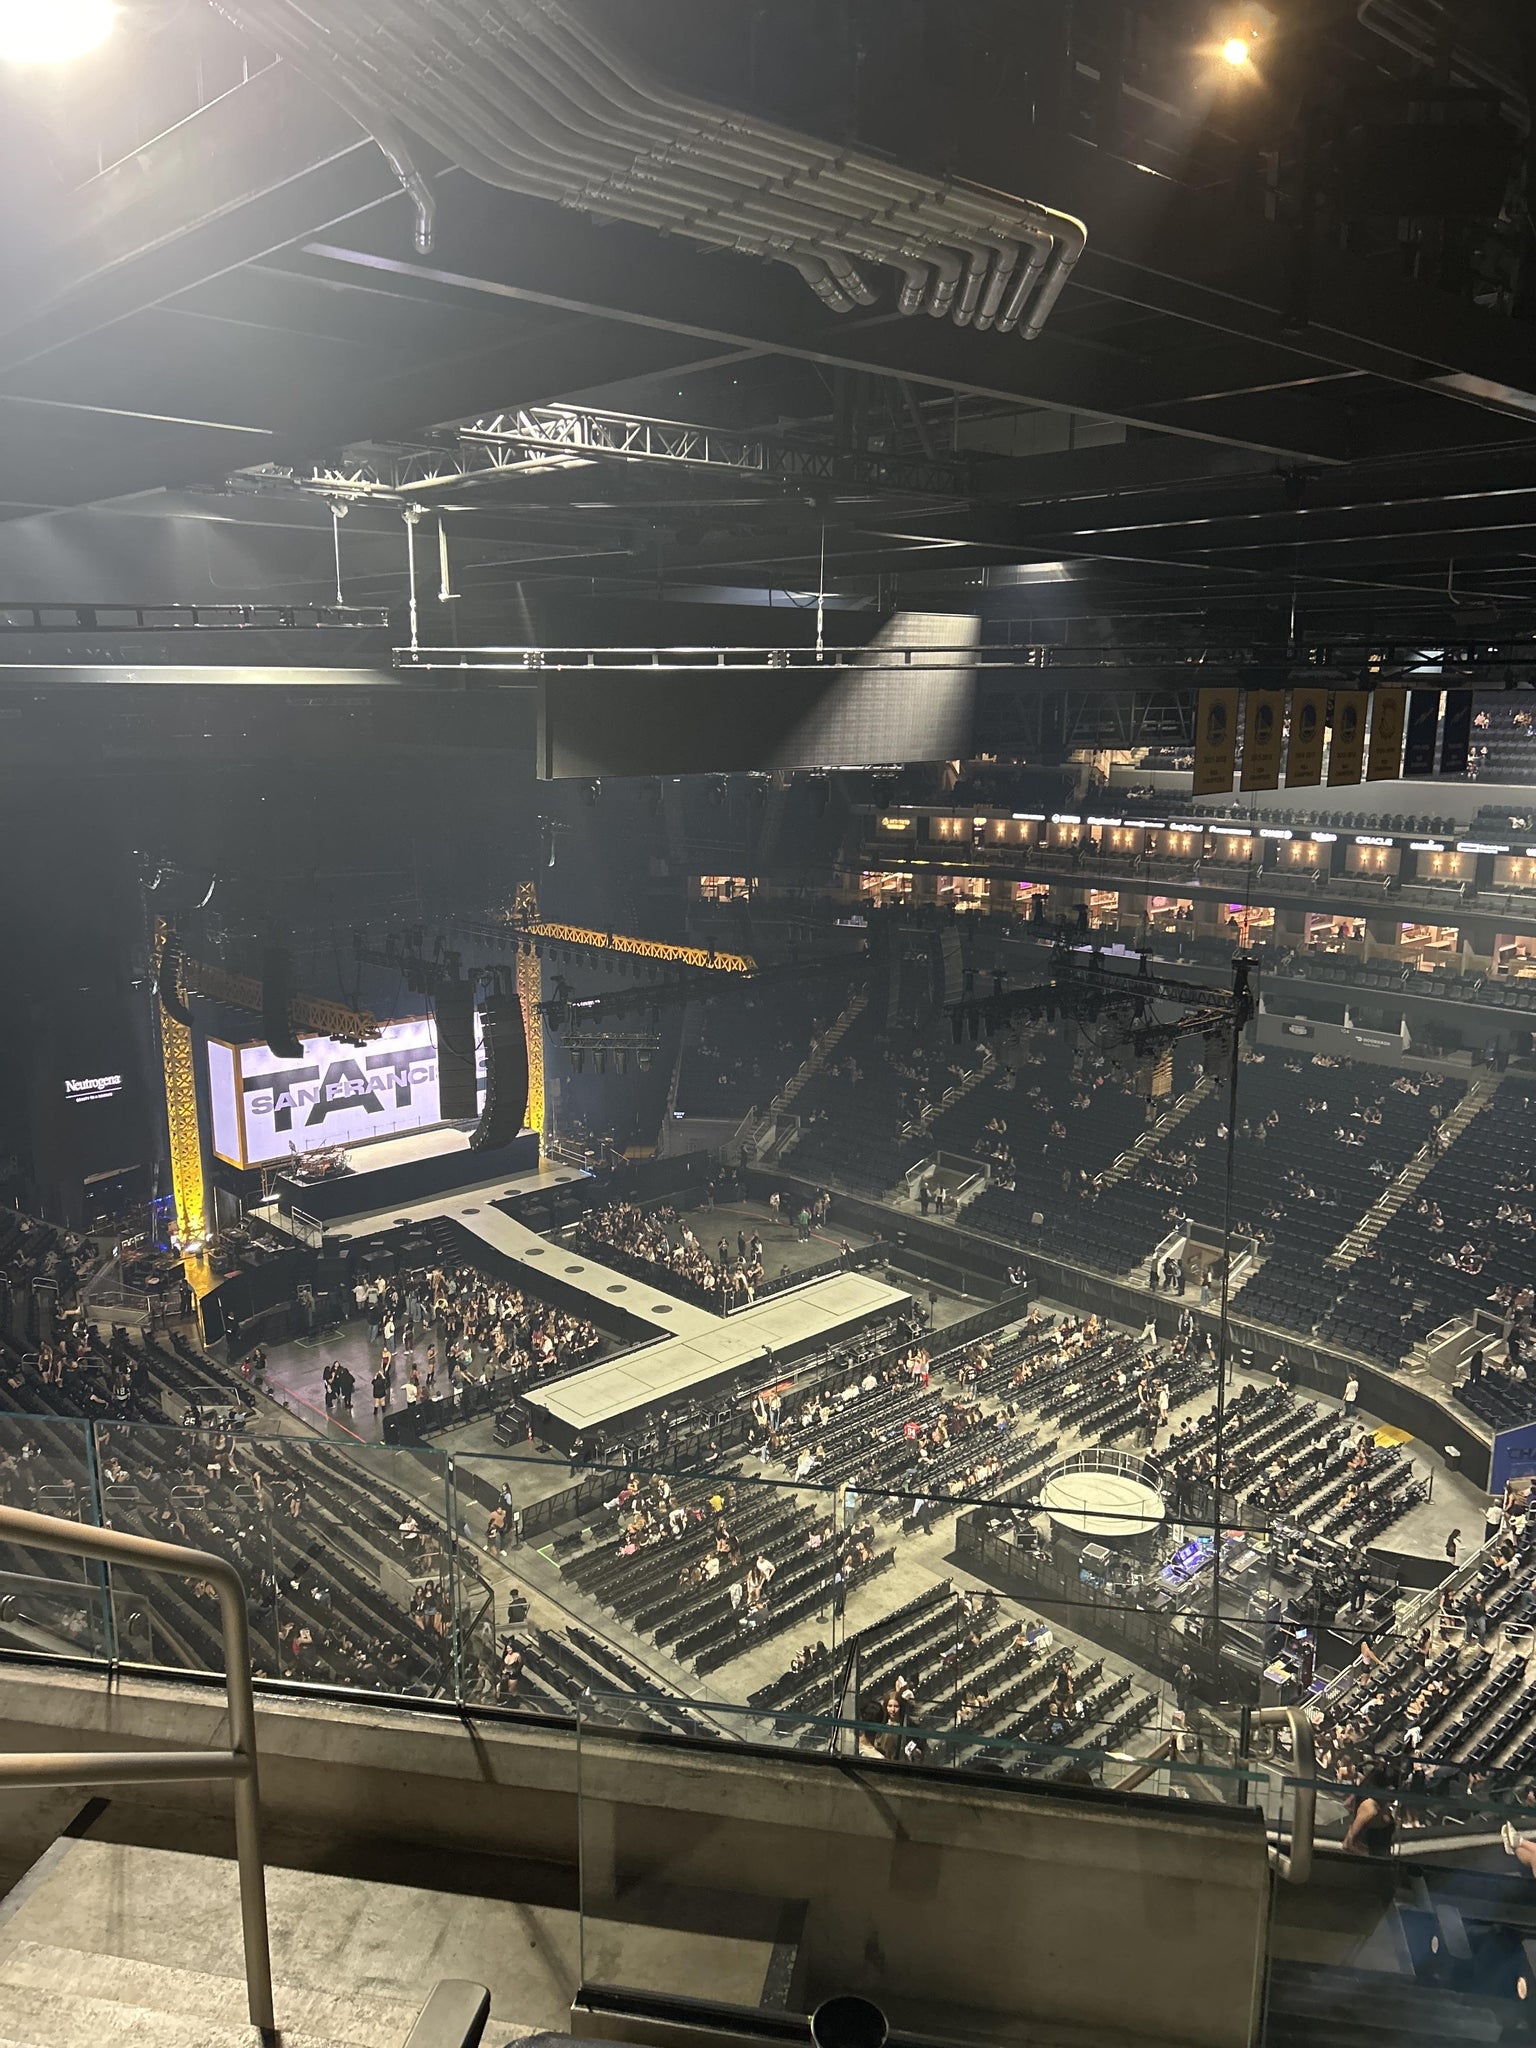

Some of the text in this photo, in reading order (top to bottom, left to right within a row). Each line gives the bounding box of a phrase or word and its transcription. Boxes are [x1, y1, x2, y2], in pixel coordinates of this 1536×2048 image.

[65, 1075, 122, 1093] Neutrogena
[243, 1046, 437, 1132] TAT
[252, 1067, 439, 1115] SAN FRANCI
